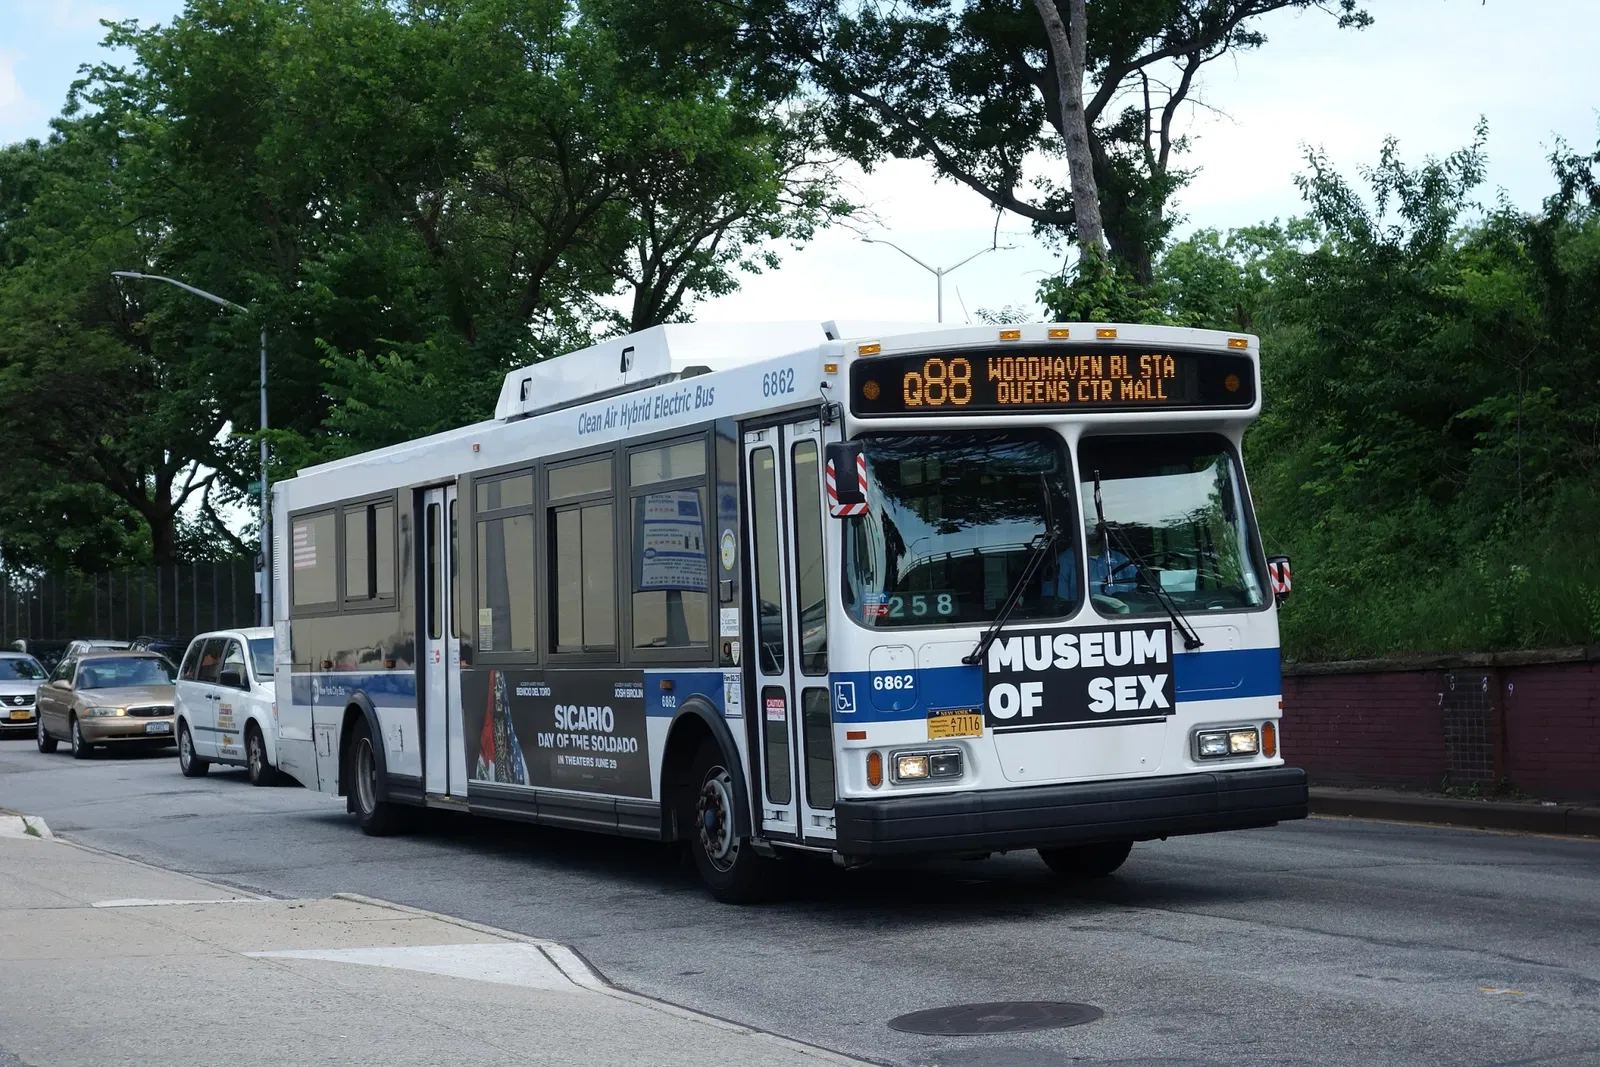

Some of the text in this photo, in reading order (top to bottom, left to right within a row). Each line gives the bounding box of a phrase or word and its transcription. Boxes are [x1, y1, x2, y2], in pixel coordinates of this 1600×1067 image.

[988, 354, 1175, 381] WOODHAVEN BL STA
[763, 368, 795, 397] 6862
[903, 357, 972, 406] Q88
[997, 378, 1168, 404] QUEENS CTR MALL
[578, 385, 715, 435] Clean Air Hybrid Electric Bus
[988, 629, 1168, 673] MUSEUM
[873, 674, 914, 690] 6862
[661, 695, 676, 708] 6862
[767, 699, 785, 708] CAUTION
[988, 674, 1170, 719] OF SEX
[1438, 692, 1444, 706] 7
[554, 704, 615, 733] SICARIO
[537, 732, 638, 753] DAY OF THE SOLDADO
[557, 754, 617, 769] IN THEATERS JUNE 29
